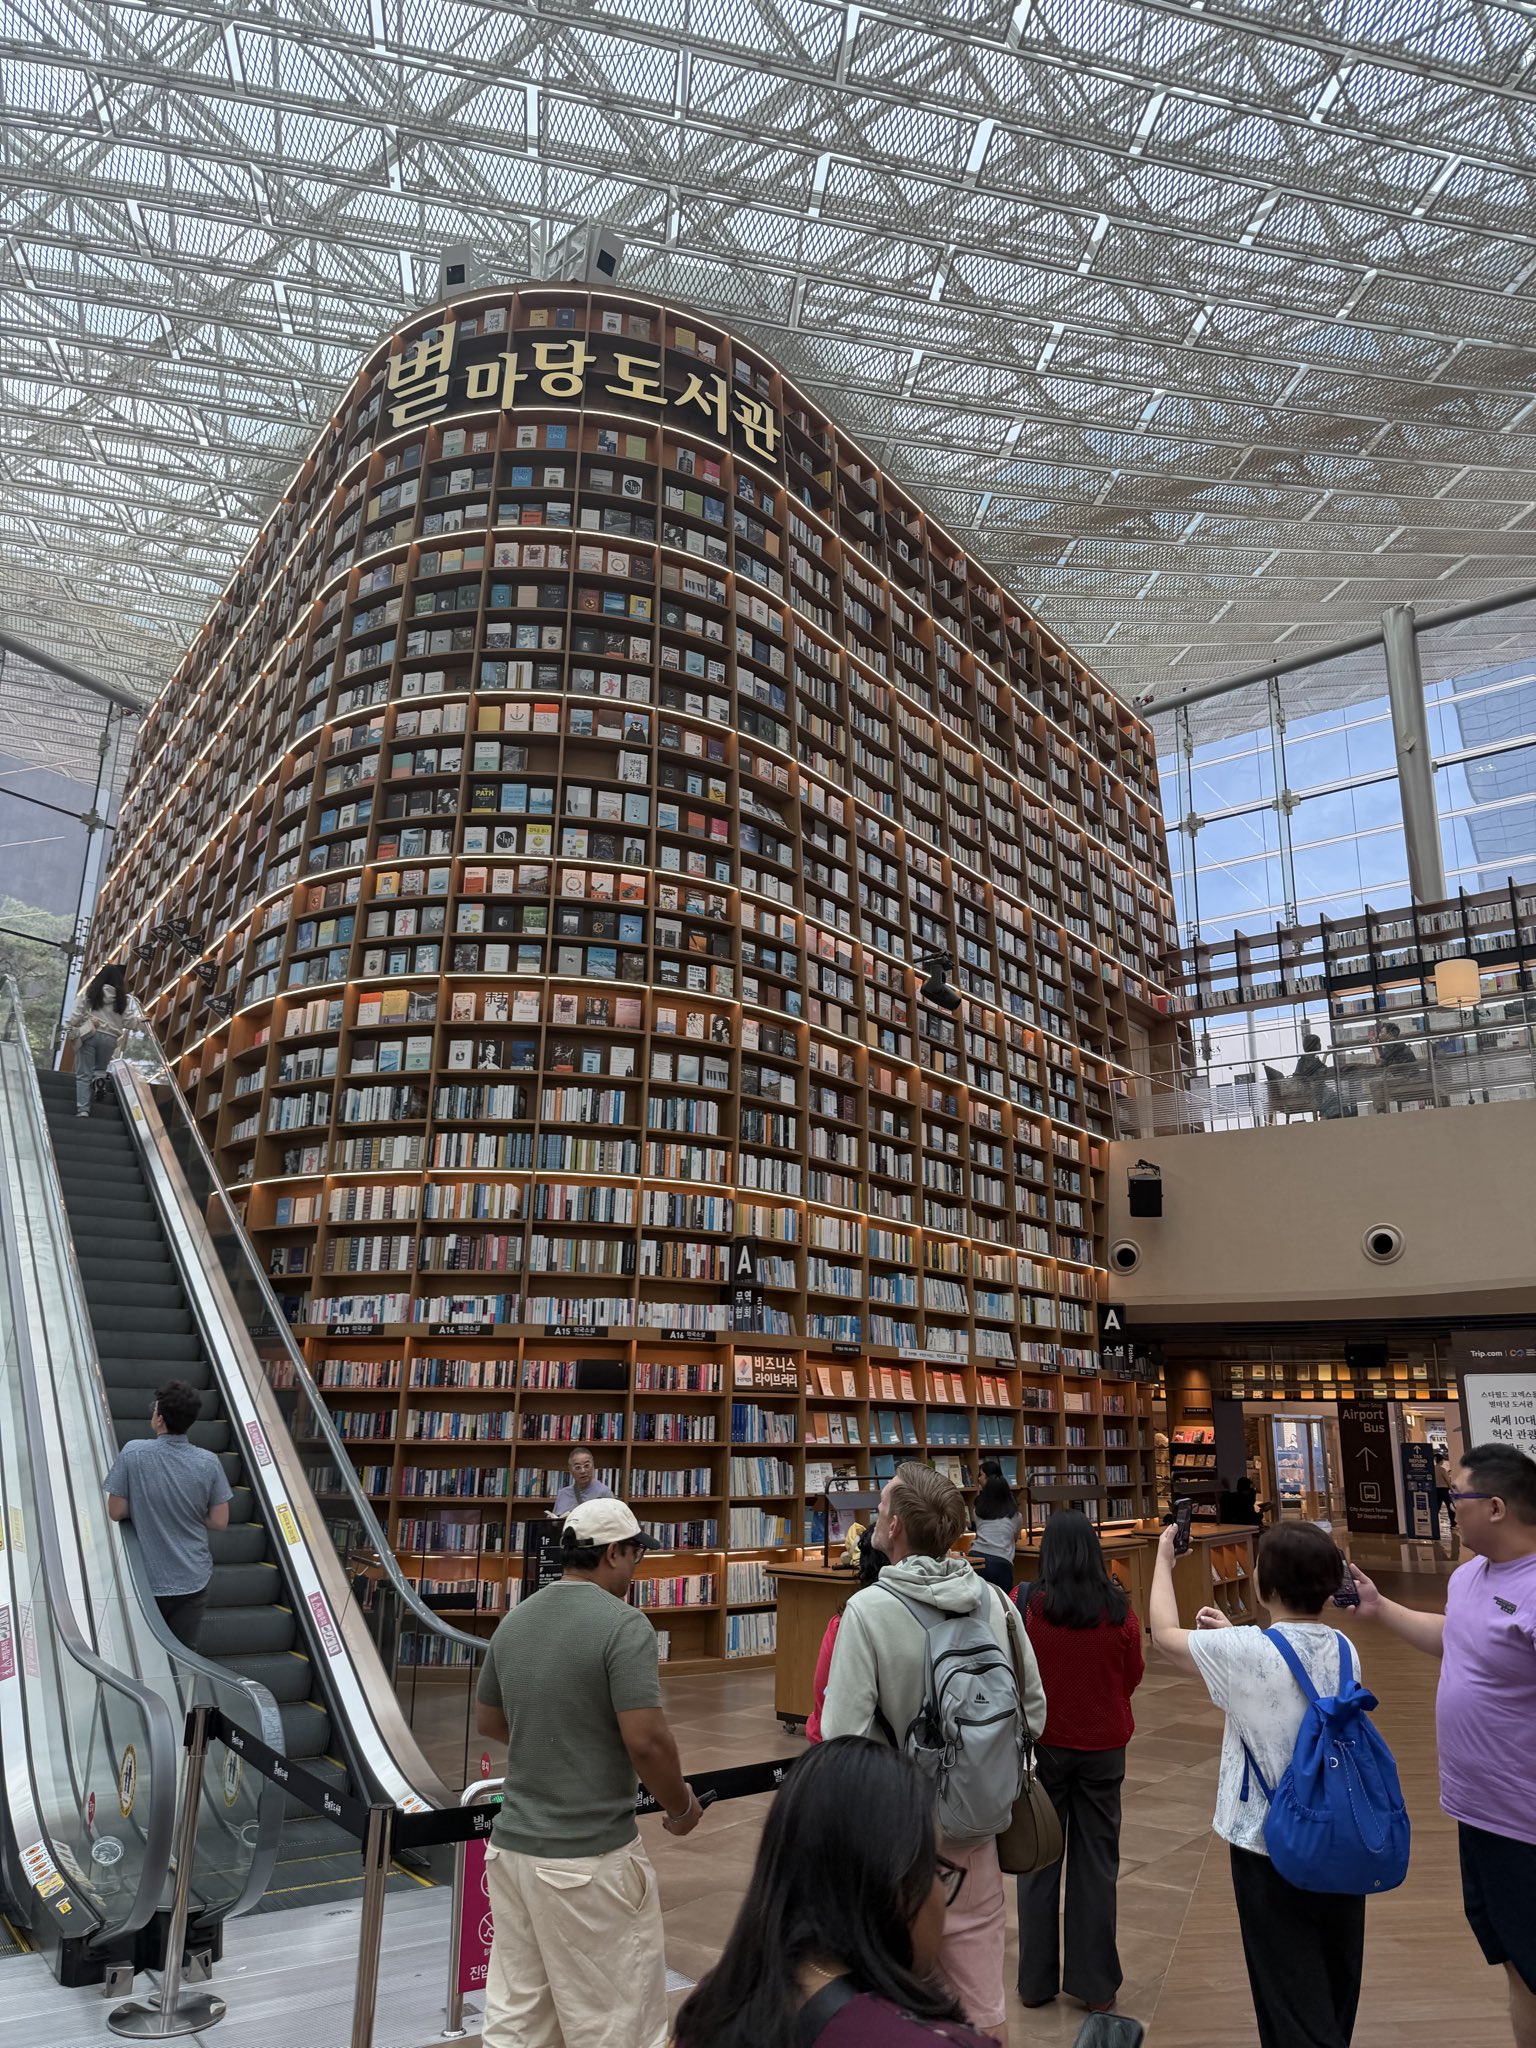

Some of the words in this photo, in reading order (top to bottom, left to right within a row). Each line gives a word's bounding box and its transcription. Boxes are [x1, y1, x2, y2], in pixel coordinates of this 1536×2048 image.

[387, 320, 597, 428] 별마당
[605, 352, 782, 464] 도서관
[212, 999, 227, 1009] 주의
[736, 1245, 752, 1274] A
[1104, 1309, 1121, 1330] A
[335, 1326, 350, 1334] A13
[439, 1326, 455, 1334] A14
[554, 1327, 571, 1335] A15
[669, 1330, 685, 1339] A16
[1102, 1345, 1125, 1357] 소설
[1470, 1350, 1503, 1358] Trip.com
[754, 1356, 797, 1372] 비즈니스
[755, 1372, 798, 1388] 라이브러리
[1489, 1400, 1510, 1408] 별마당
[1512, 1400, 1534, 1408] 도서관
[1342, 1408, 1385, 1422] Airport
[1490, 1414, 1512, 1425] 세계
[1363, 1422, 1386, 1433] Bus
[1492, 1428, 1513, 1440] 혁신
[541, 1536, 551, 1546] 1F
